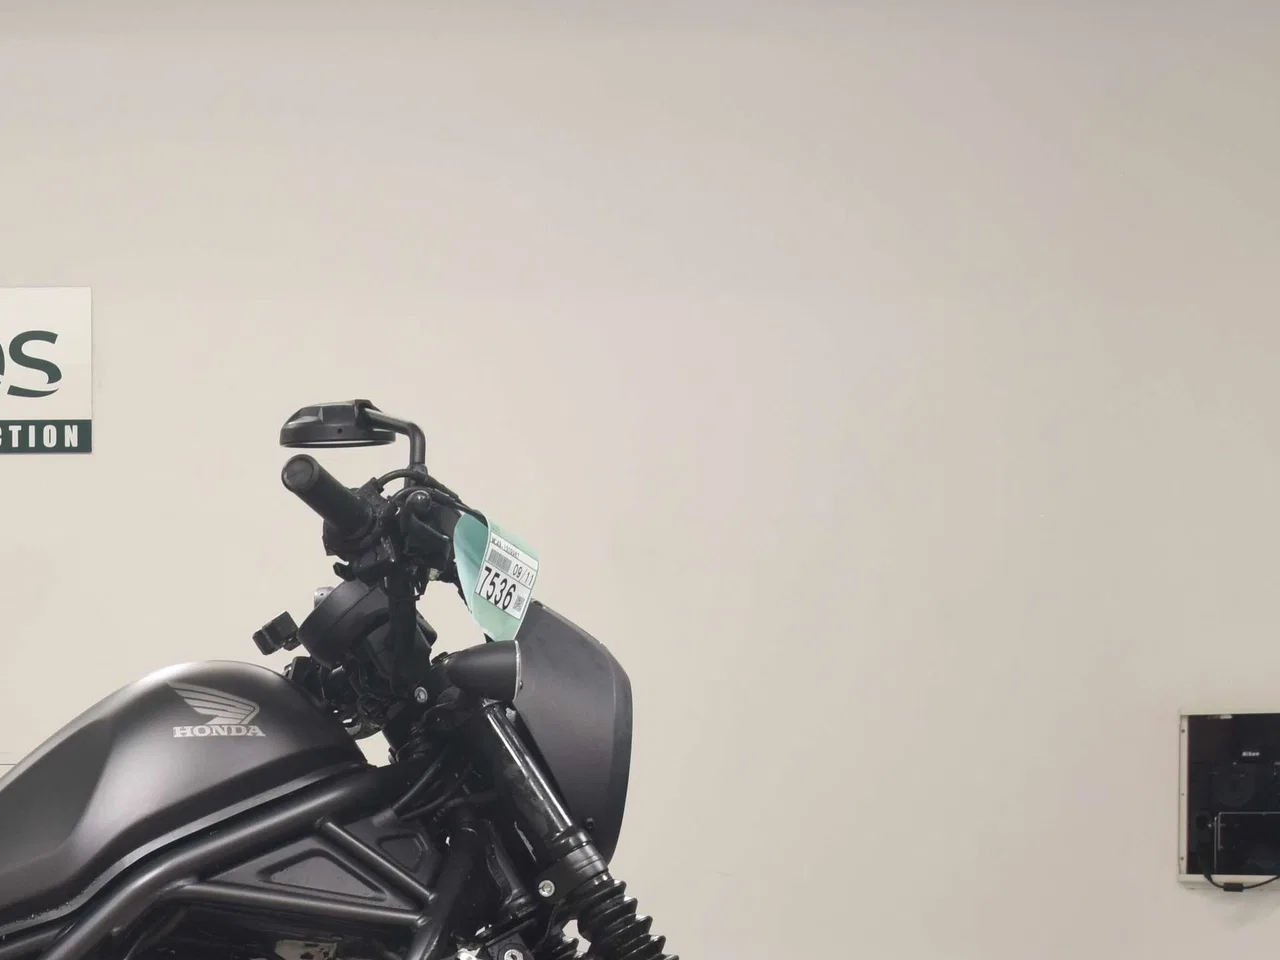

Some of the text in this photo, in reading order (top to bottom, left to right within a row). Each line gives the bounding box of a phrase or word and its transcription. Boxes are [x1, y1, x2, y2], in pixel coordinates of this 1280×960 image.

[512, 563, 535, 587] 09/11
[478, 566, 516, 611] 7536
[172, 725, 266, 738] HONDA
